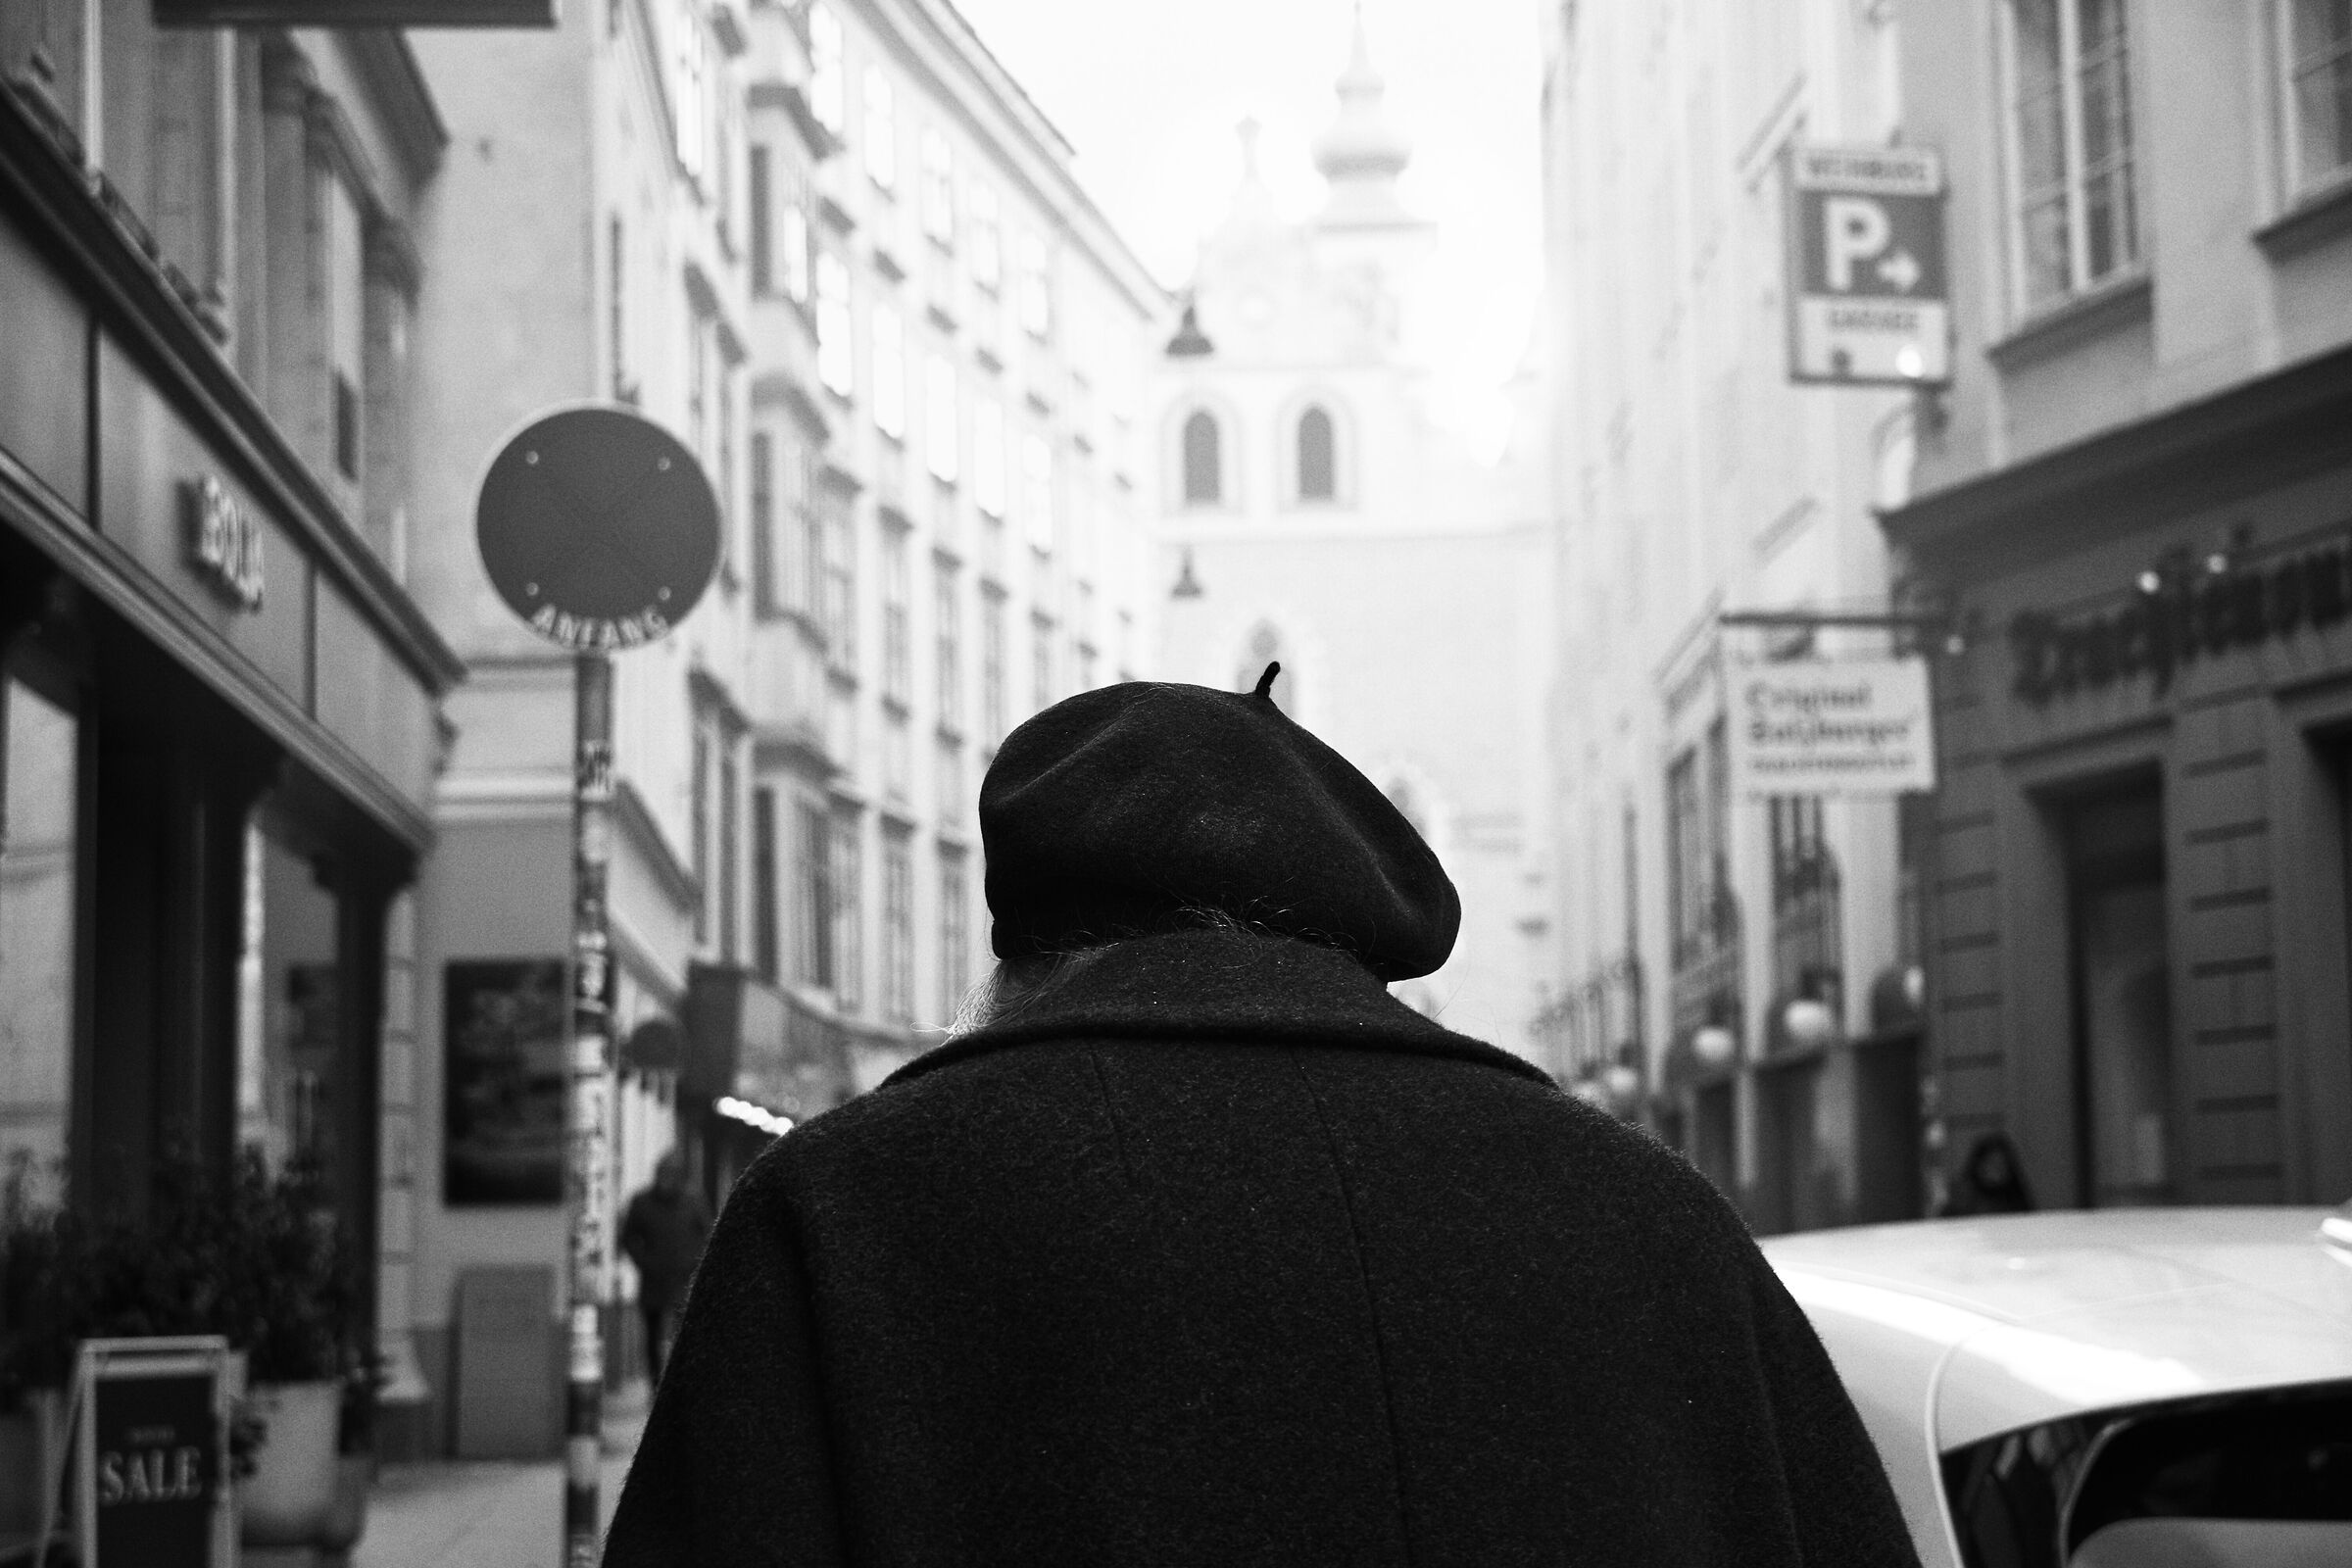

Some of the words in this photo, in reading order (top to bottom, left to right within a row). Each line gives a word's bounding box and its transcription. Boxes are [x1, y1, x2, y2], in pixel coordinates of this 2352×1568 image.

[1825, 197, 1892, 291] P
[530, 603, 669, 651] ANFANG
[99, 1446, 203, 1507] SALE
